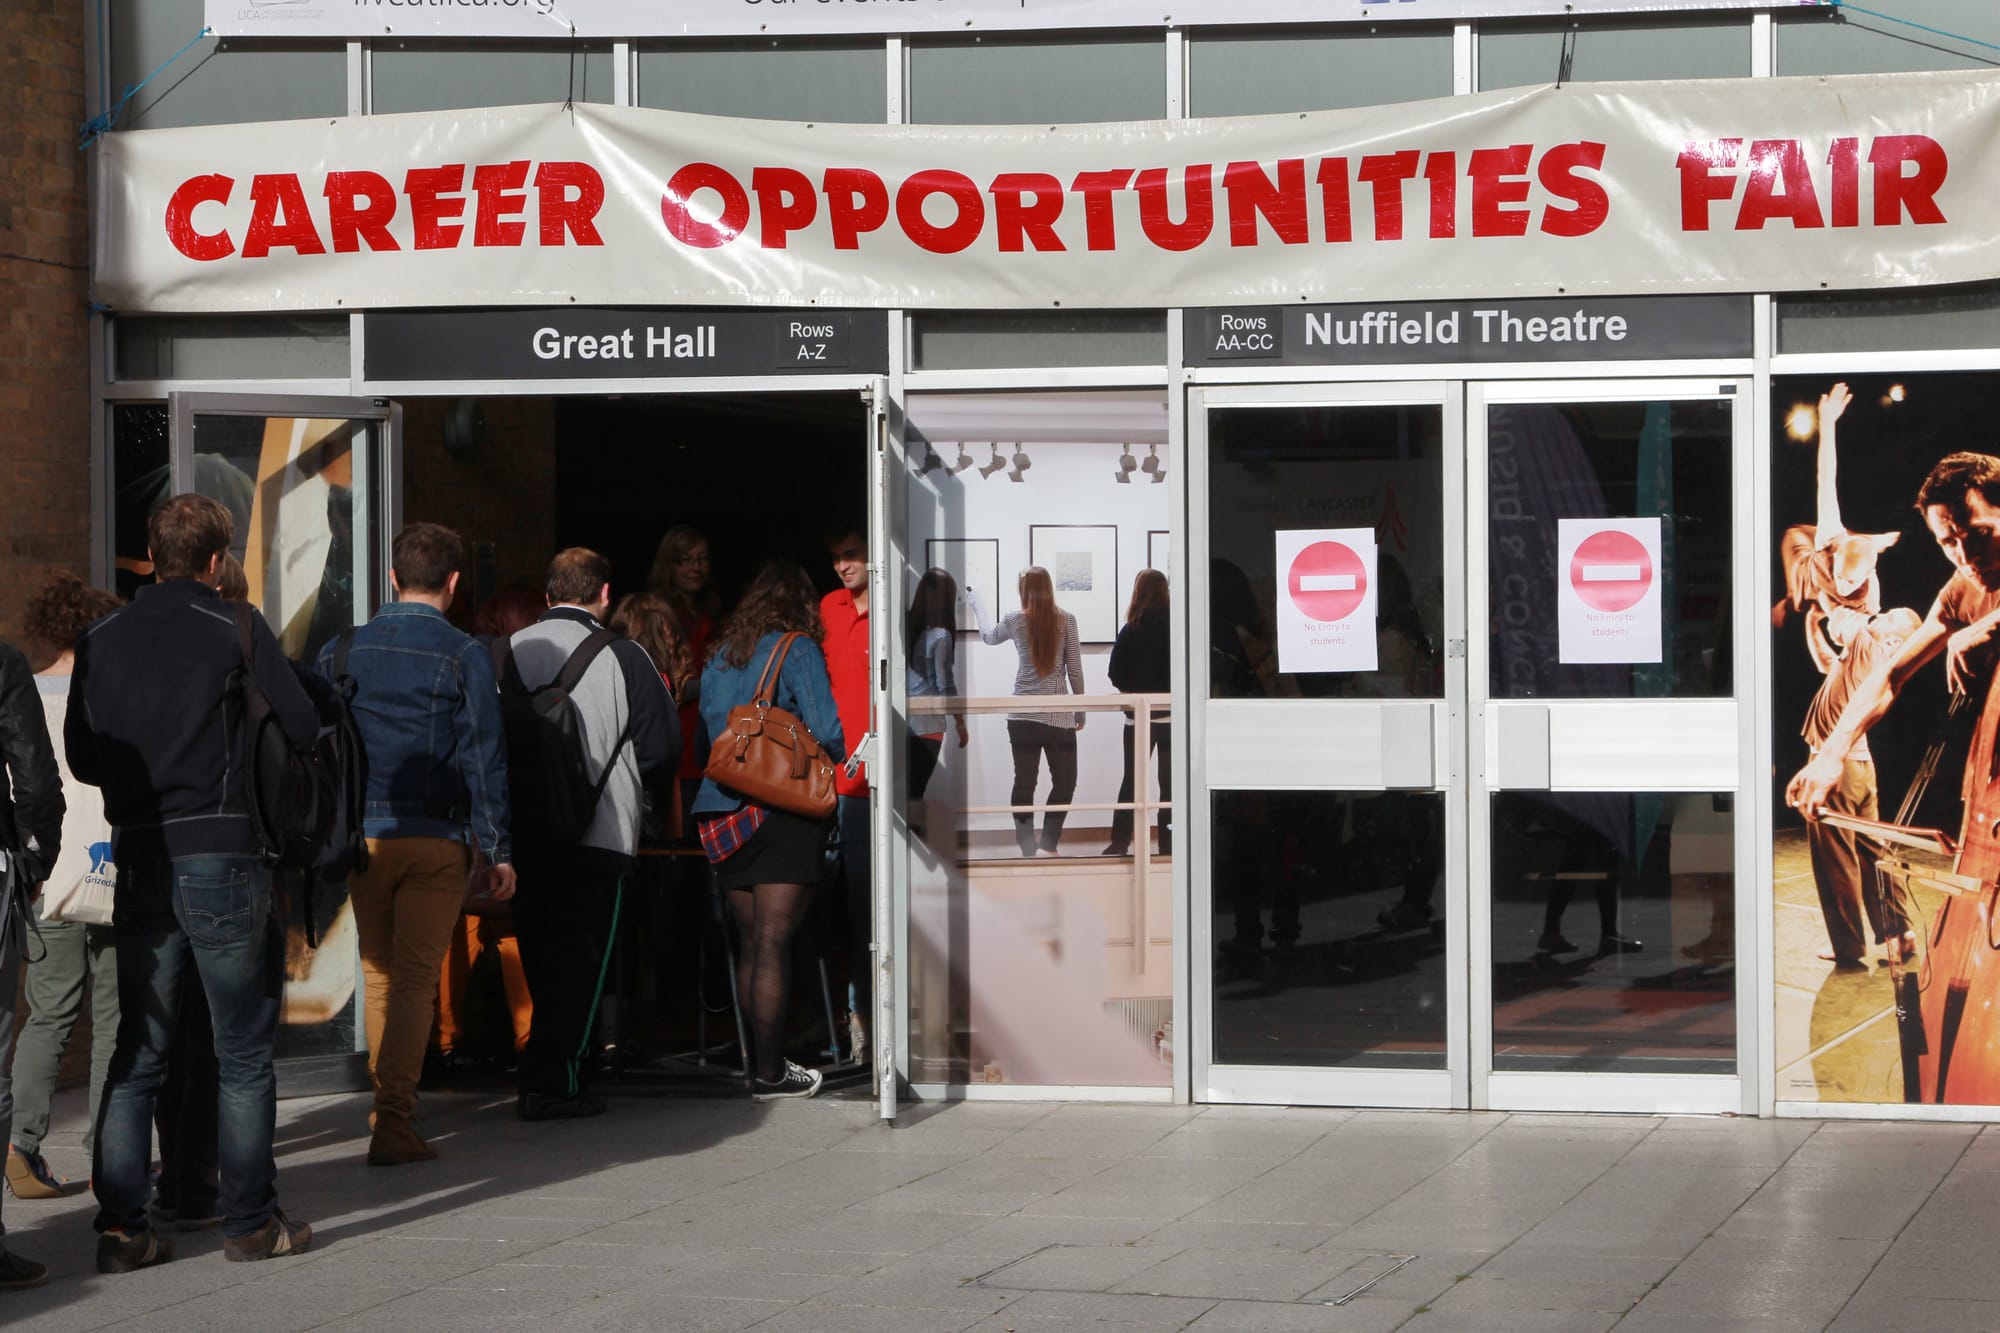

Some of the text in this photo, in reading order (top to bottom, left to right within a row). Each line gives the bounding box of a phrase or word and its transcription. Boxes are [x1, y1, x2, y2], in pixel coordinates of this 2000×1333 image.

[165, 135, 1948, 261] CAREER OPPORTUNITIES FAIR
[790, 322, 834, 338] Rows
[1221, 314, 1267, 331] Rows
[1305, 309, 1627, 346] Nuffield Theatre
[532, 326, 715, 359] Great Hall
[1215, 333, 1273, 351] AA-CC
[797, 343, 826, 360] A-Z
[1585, 613, 1599, 622] No
[1304, 623, 1350, 632] No Entry to
[1310, 637, 1346, 646] students
